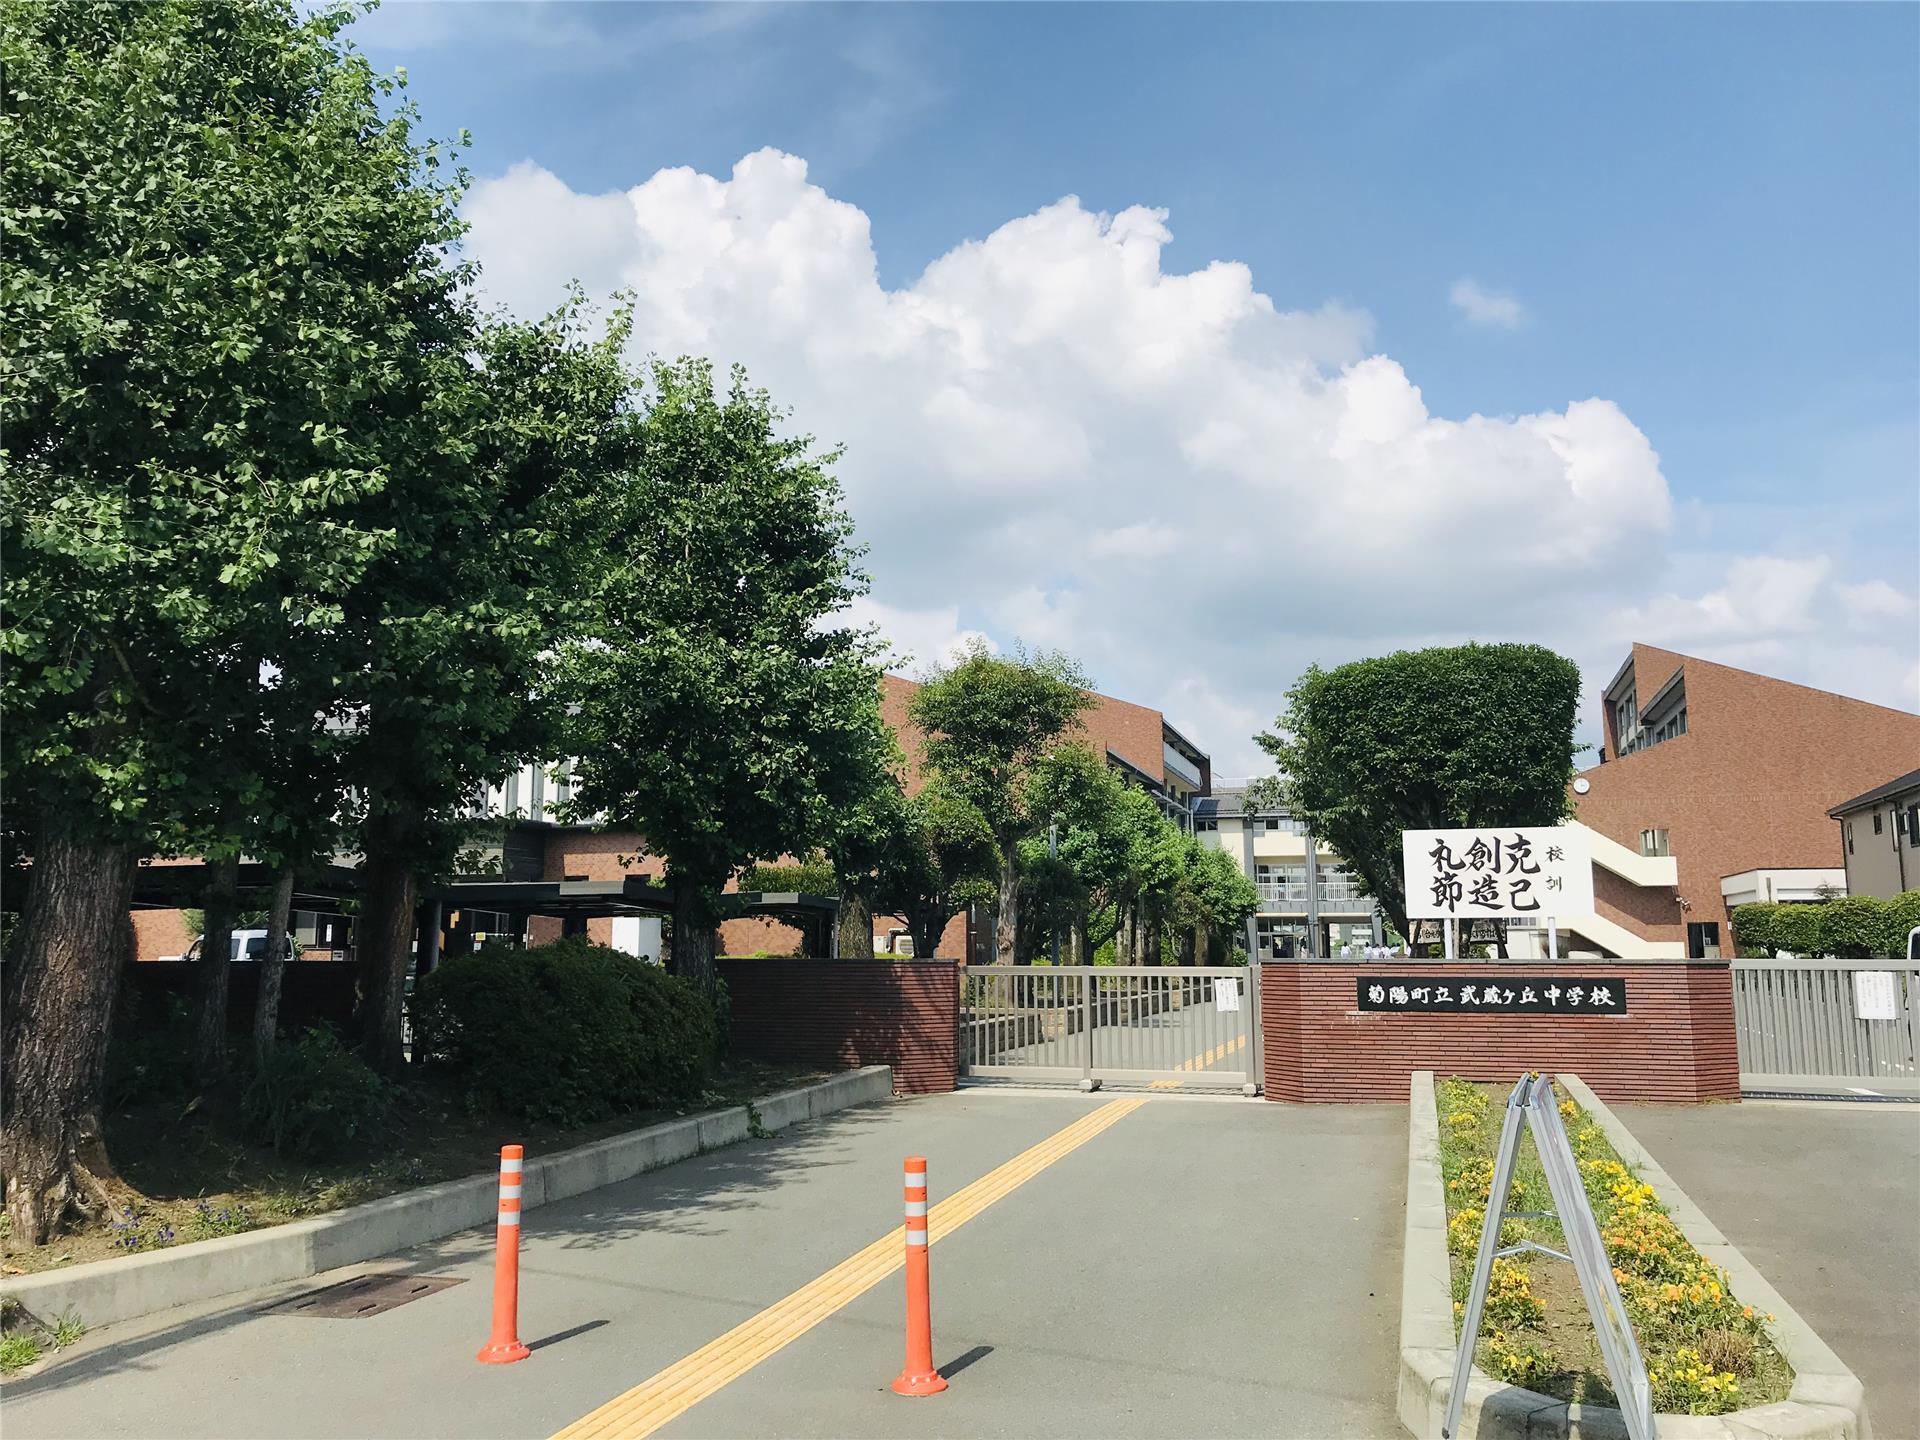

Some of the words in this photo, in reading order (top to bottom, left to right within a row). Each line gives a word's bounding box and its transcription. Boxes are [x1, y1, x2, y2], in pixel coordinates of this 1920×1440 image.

[1428, 838, 1466, 913] 礼節
[1464, 836, 1505, 911] 創造
[1504, 832, 1541, 912] 克己
[1545, 845, 1565, 892] 校訓
